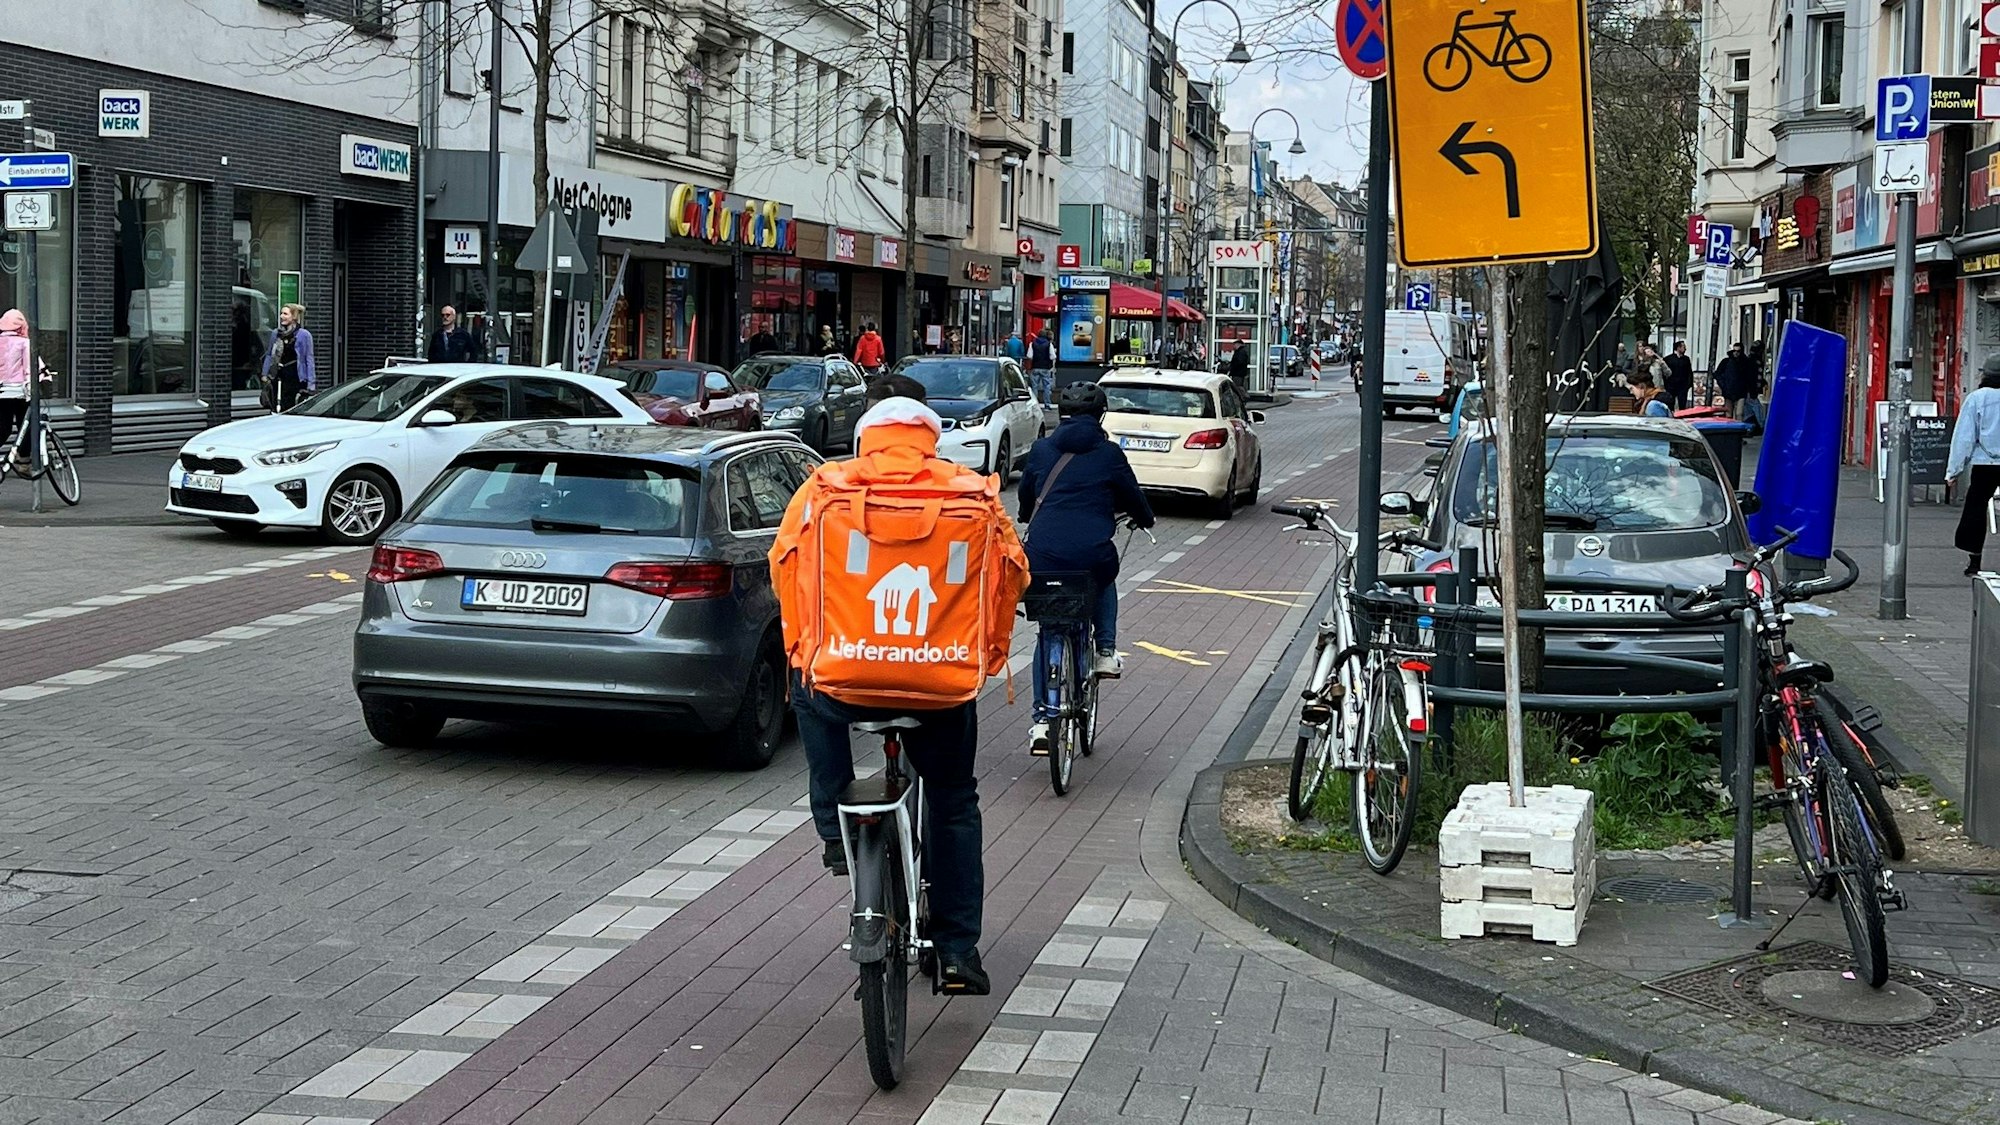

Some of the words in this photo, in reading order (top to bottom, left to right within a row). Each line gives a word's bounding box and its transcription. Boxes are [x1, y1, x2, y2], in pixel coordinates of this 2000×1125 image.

[103, 98, 138, 113] back
[102, 116, 140, 130] WERK
[8, 166, 66, 176] Einbahnstraße
[554, 176, 632, 227] NetCologne
[1216, 240, 1263, 261] SONY
[475, 582, 490, 602] K
[502, 583, 528, 604] UD
[532, 586, 583, 607] 2009
[1572, 597, 1595, 612] PA
[1602, 597, 1650, 612] 1316
[829, 634, 970, 663] Lieferando.de
